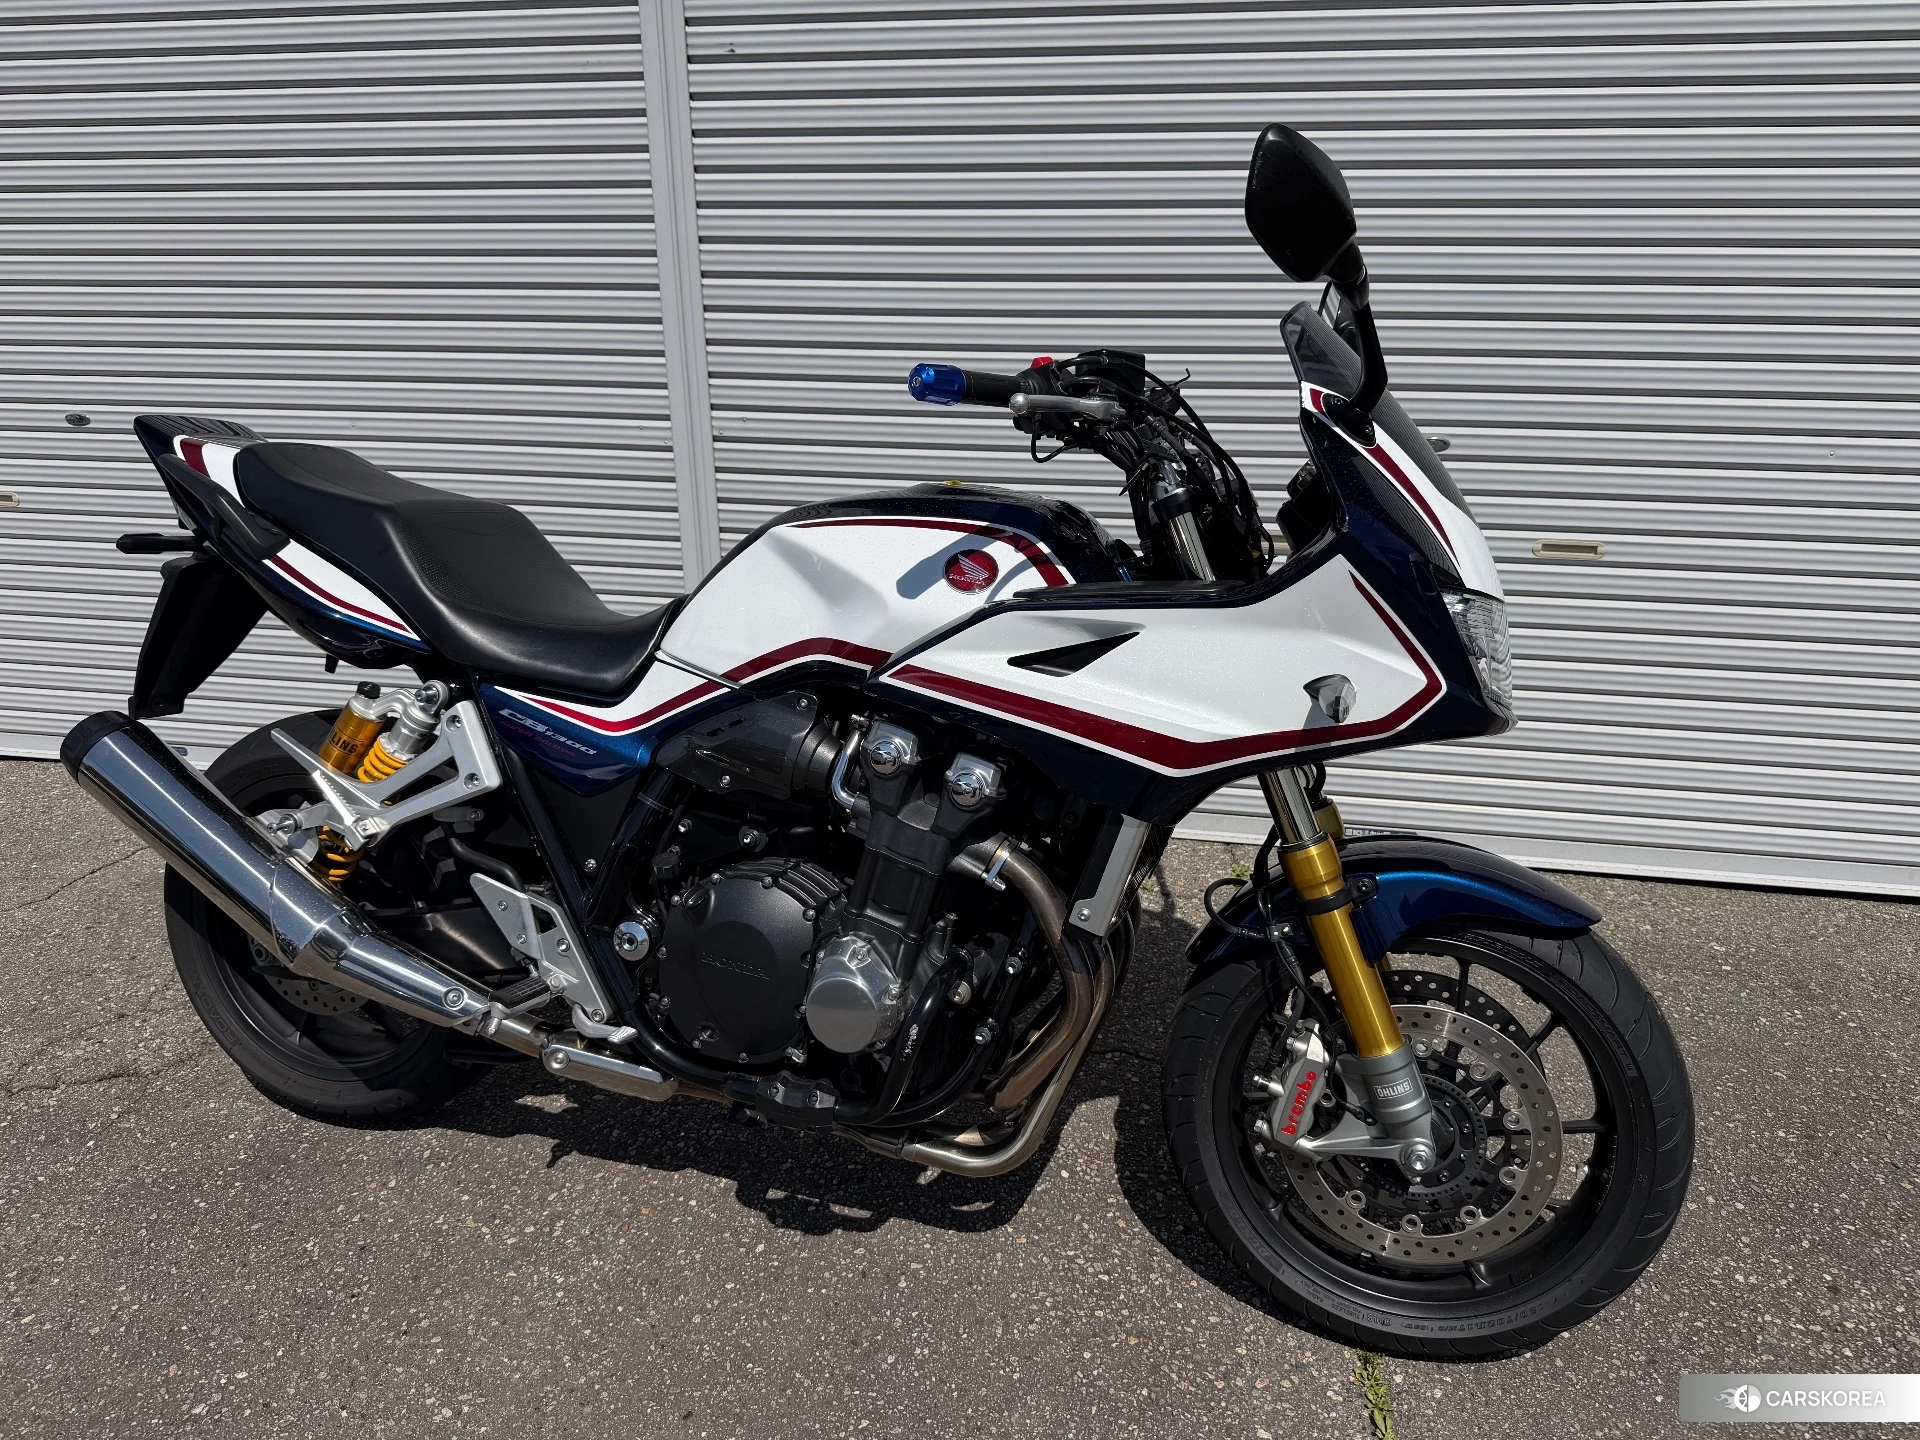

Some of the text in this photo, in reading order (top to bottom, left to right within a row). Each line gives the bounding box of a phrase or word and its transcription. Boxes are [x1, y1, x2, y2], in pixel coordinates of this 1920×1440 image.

[330, 731, 359, 755] LINS
[1377, 1081, 1411, 1098] ÖHLINS
[1280, 1070, 1317, 1136] brembo
